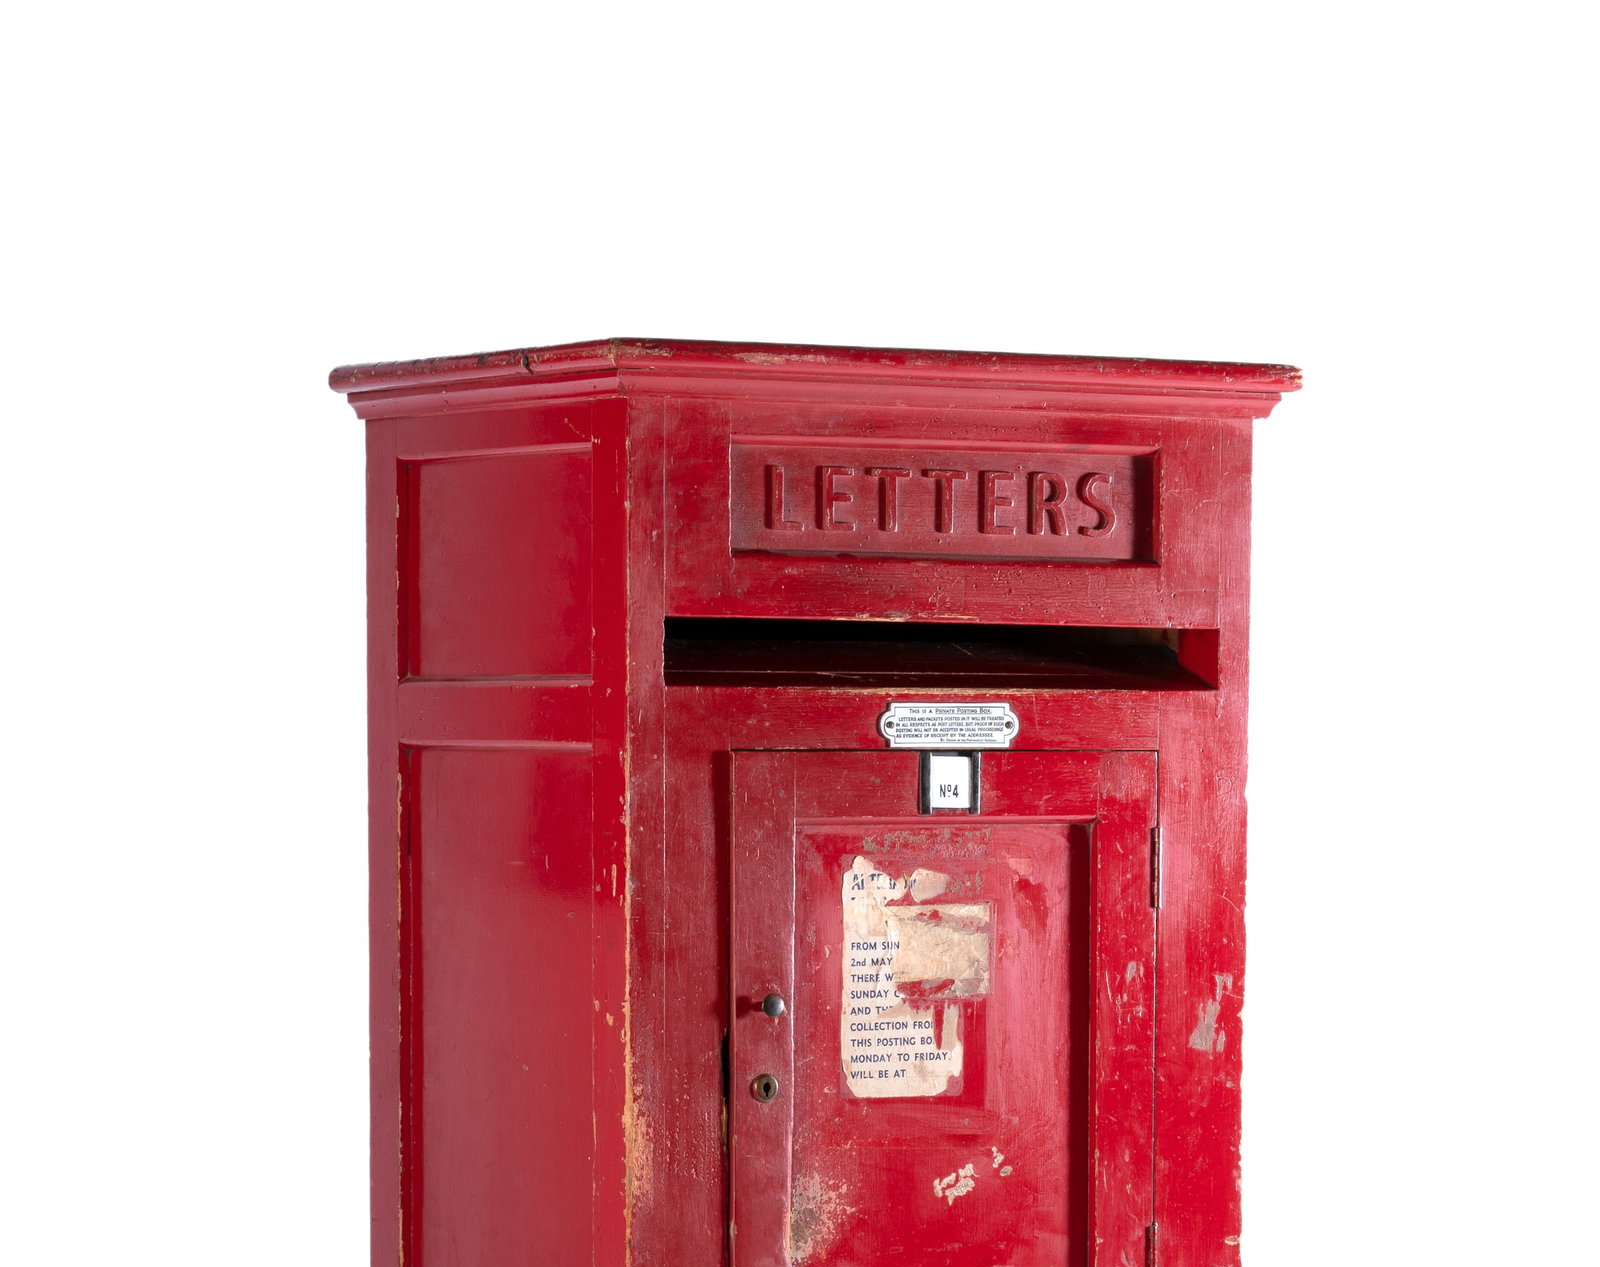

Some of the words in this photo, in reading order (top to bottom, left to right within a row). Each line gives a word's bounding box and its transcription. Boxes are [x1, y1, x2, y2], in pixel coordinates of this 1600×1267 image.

[765, 465, 1117, 536] LETTERS
[851, 942, 877, 950] FROM
[851, 958, 866, 966] 2nd
[872, 958, 893, 966] MAY
[851, 974, 880, 982] THERE
[851, 990, 889, 999] SUNDAY
[851, 1007, 871, 1015] AND
[851, 1022, 908, 1031] COLLECTION
[913, 1021, 933, 1029] FRO
[851, 1039, 872, 1047] THIS
[877, 1037, 916, 1046] POSTING
[921, 1036, 934, 1044] BO
[851, 1054, 892, 1063] MONDAY
[898, 1053, 910, 1061] TO
[851, 1071, 873, 1079] WILL
[879, 1070, 889, 1078] BE
[894, 1069, 906, 1078] AT
